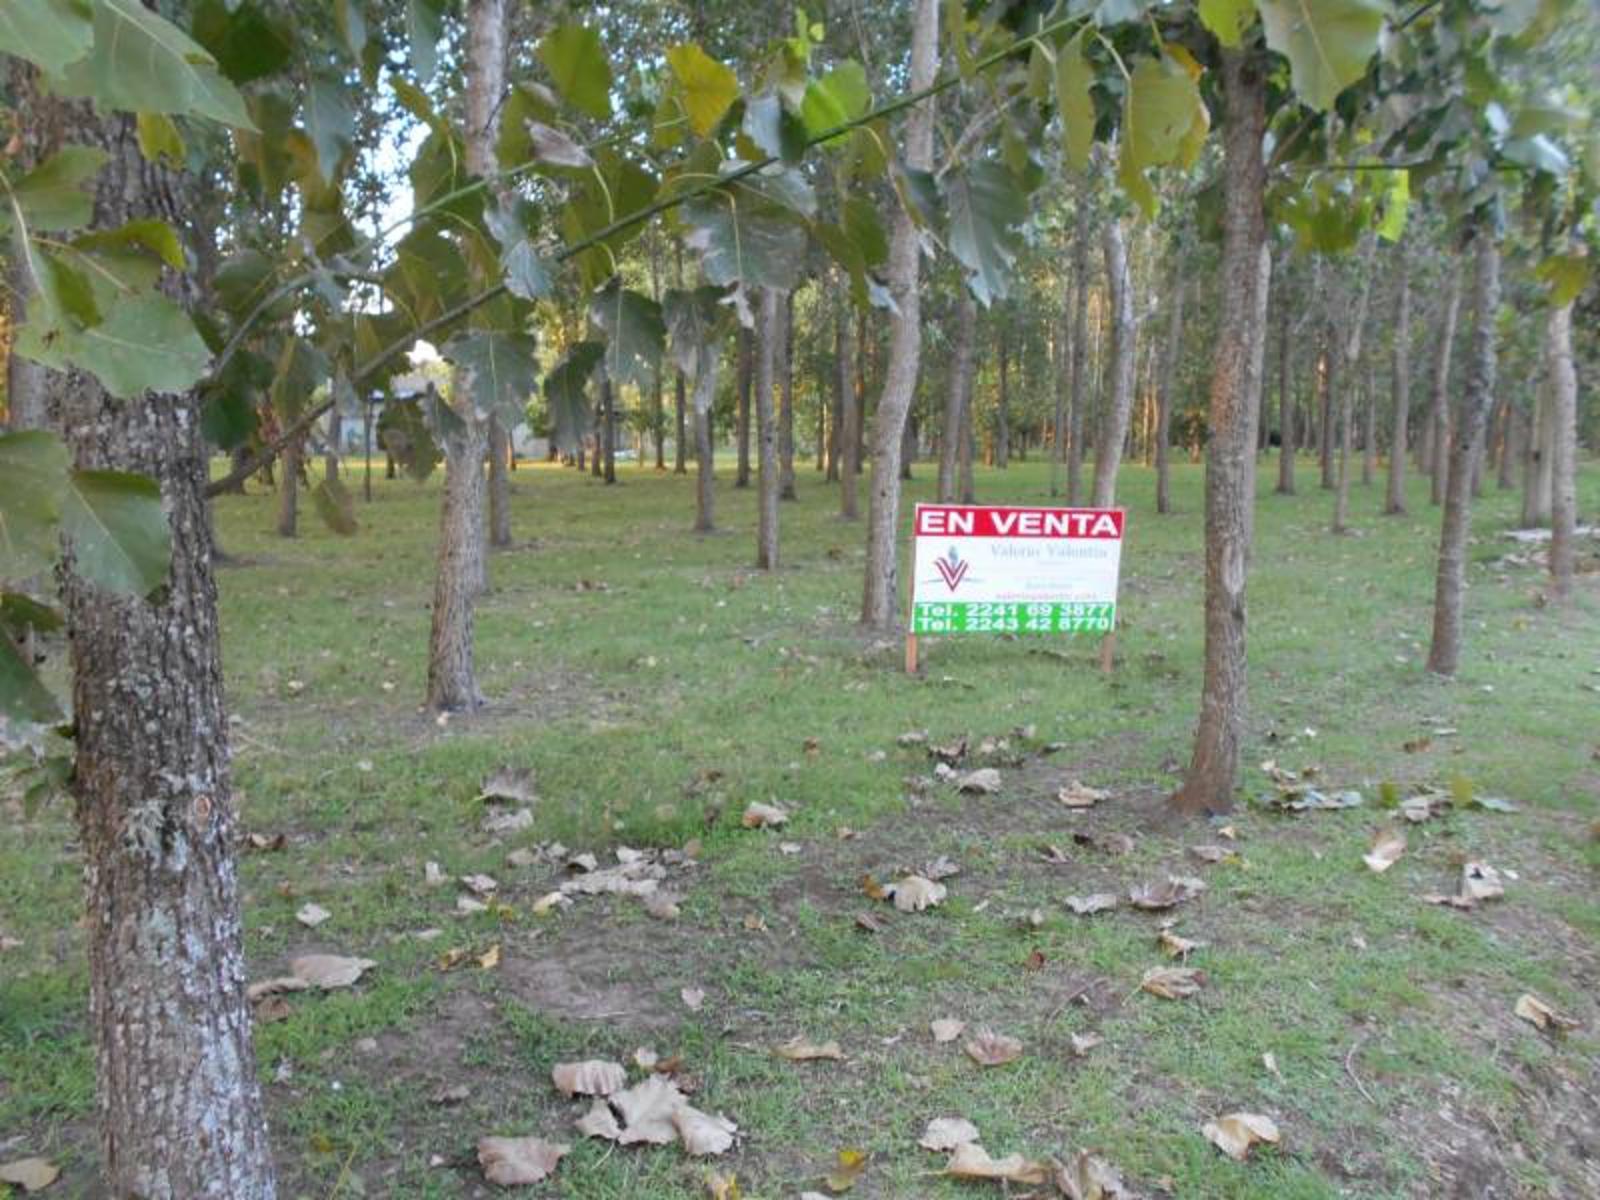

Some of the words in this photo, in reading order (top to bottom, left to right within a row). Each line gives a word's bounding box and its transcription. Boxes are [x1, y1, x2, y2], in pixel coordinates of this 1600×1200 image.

[920, 511, 975, 533] EN
[990, 512, 1118, 537] VENTA
[919, 603, 958, 617] Tel.
[966, 603, 1018, 617] 2241
[918, 617, 958, 631] Tel.
[965, 617, 1018, 631] 2243
[1025, 618, 1051, 631] 42
